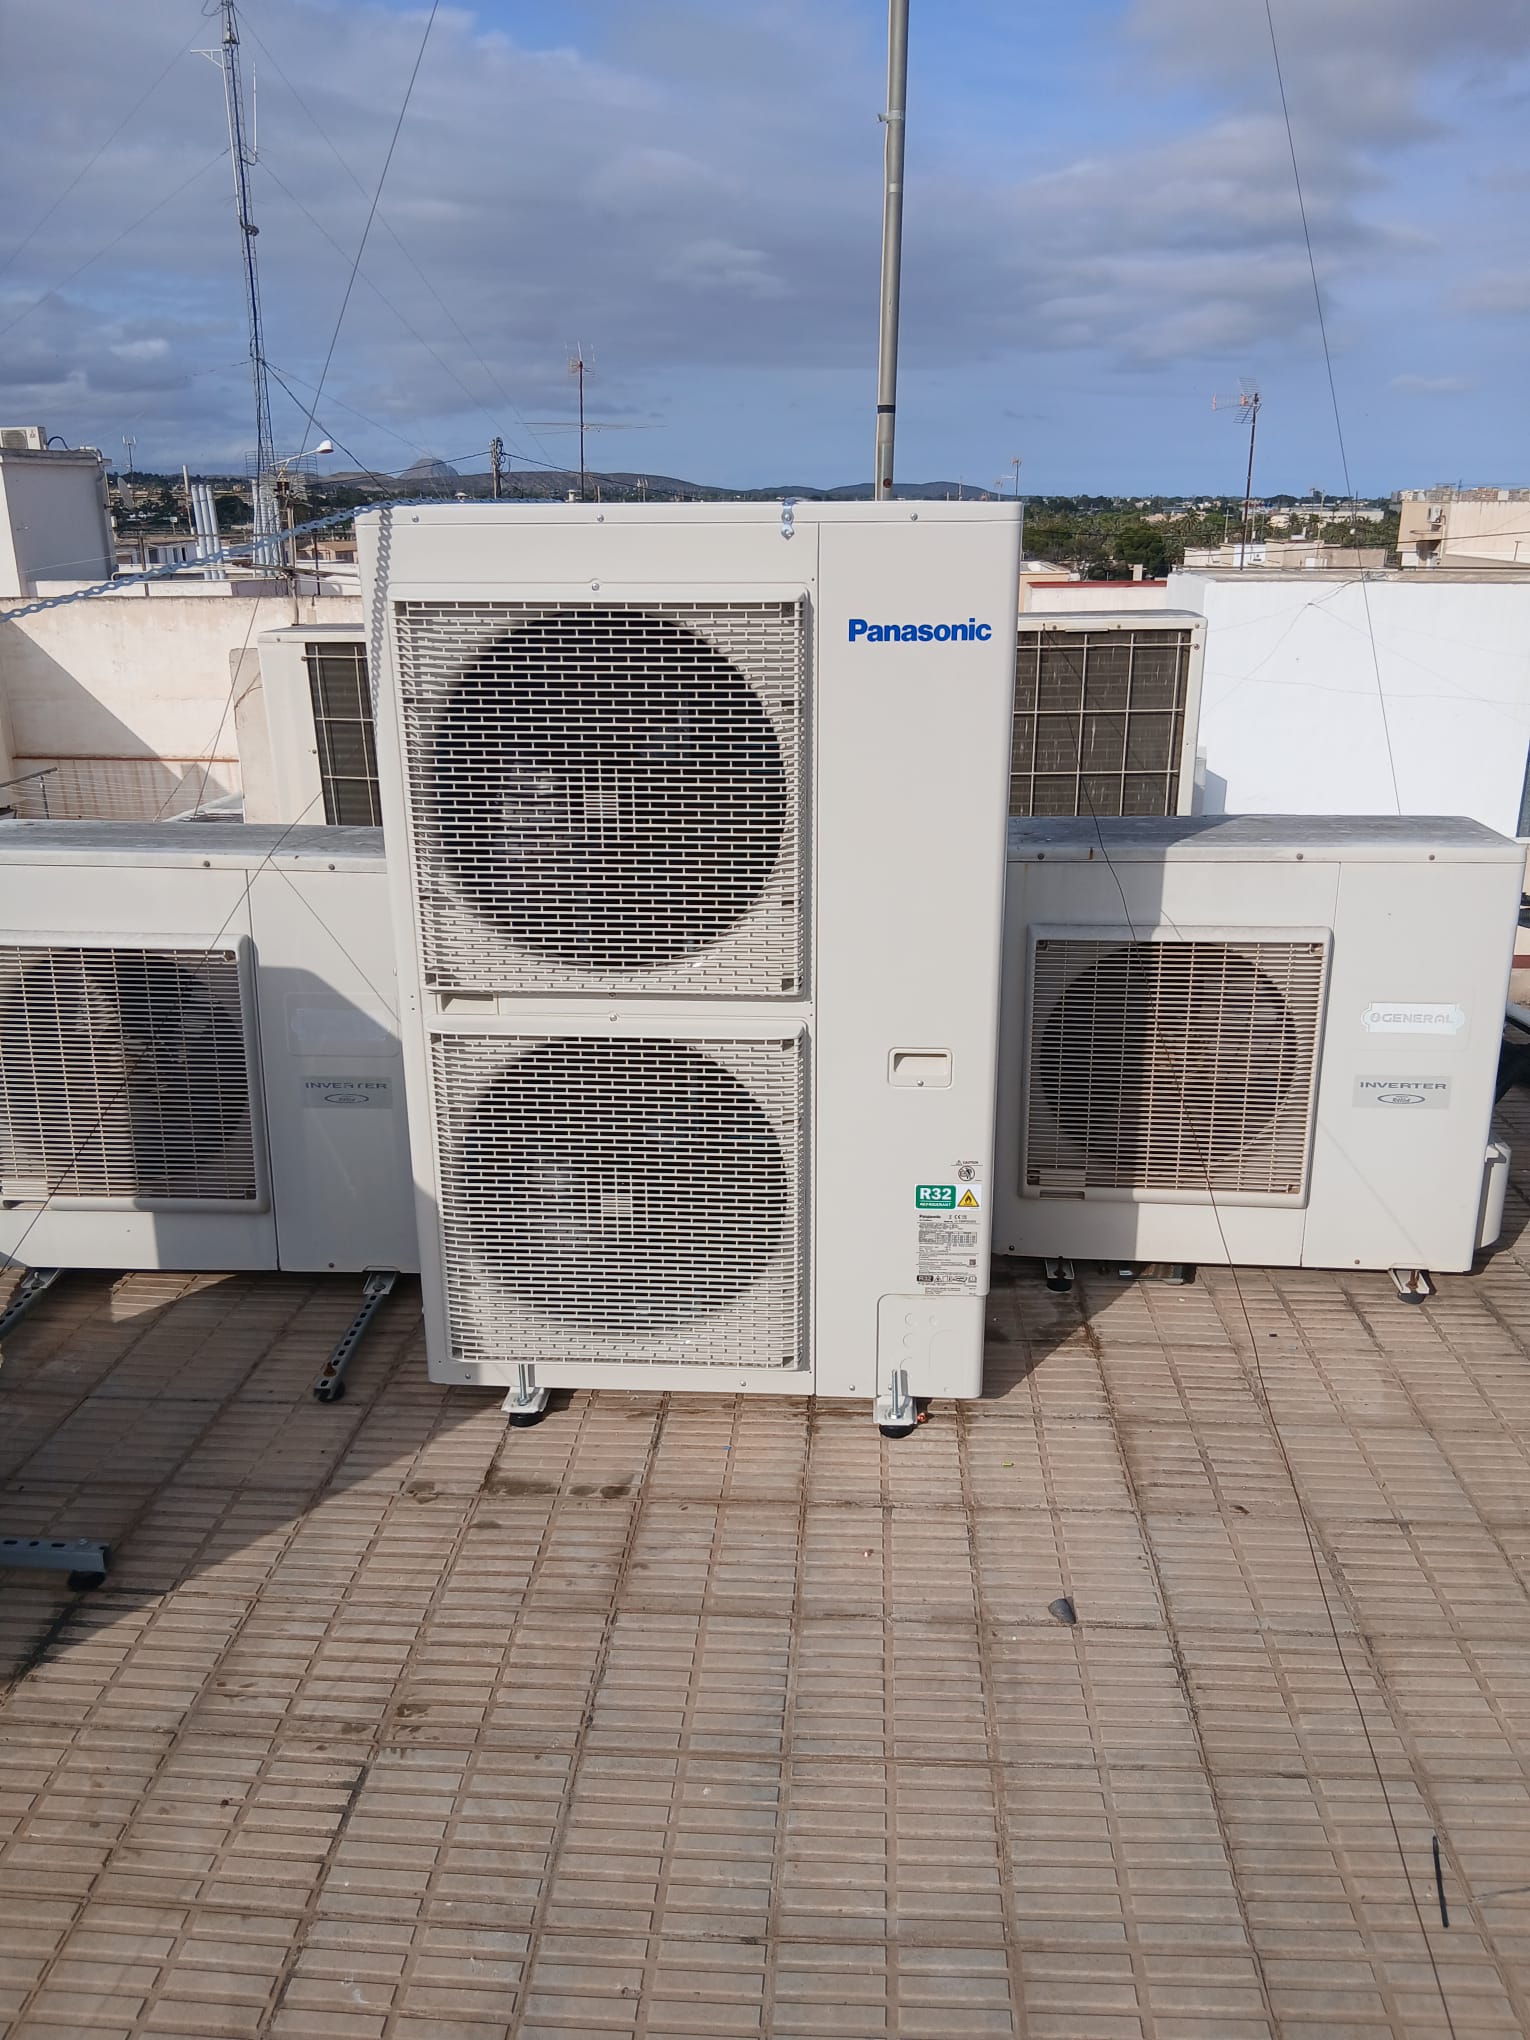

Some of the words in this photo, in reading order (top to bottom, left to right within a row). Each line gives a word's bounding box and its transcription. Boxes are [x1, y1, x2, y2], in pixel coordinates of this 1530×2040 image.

[848, 617, 992, 642] Panasonic
[1360, 1081, 1447, 1090] INVERTER
[919, 1187, 952, 1200] R32
